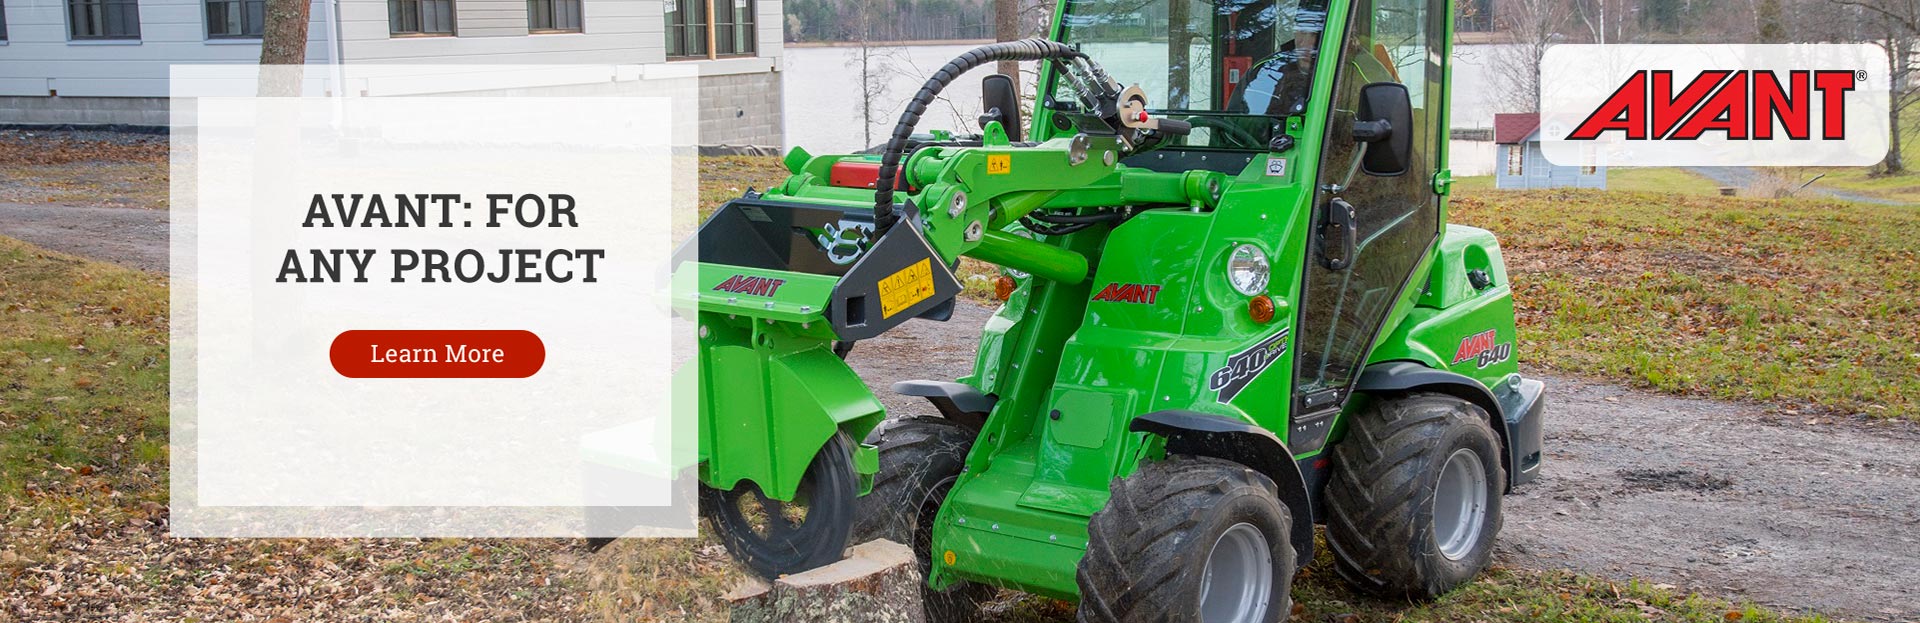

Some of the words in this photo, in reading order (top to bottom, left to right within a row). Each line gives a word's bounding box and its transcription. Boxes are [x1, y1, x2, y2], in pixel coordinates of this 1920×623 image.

[713, 274, 785, 297] AVANT
[1091, 283, 1161, 304] AVANT
[1450, 329, 1497, 366] AVANT
[1477, 342, 1511, 369] 640
[1209, 347, 1267, 391] 640
